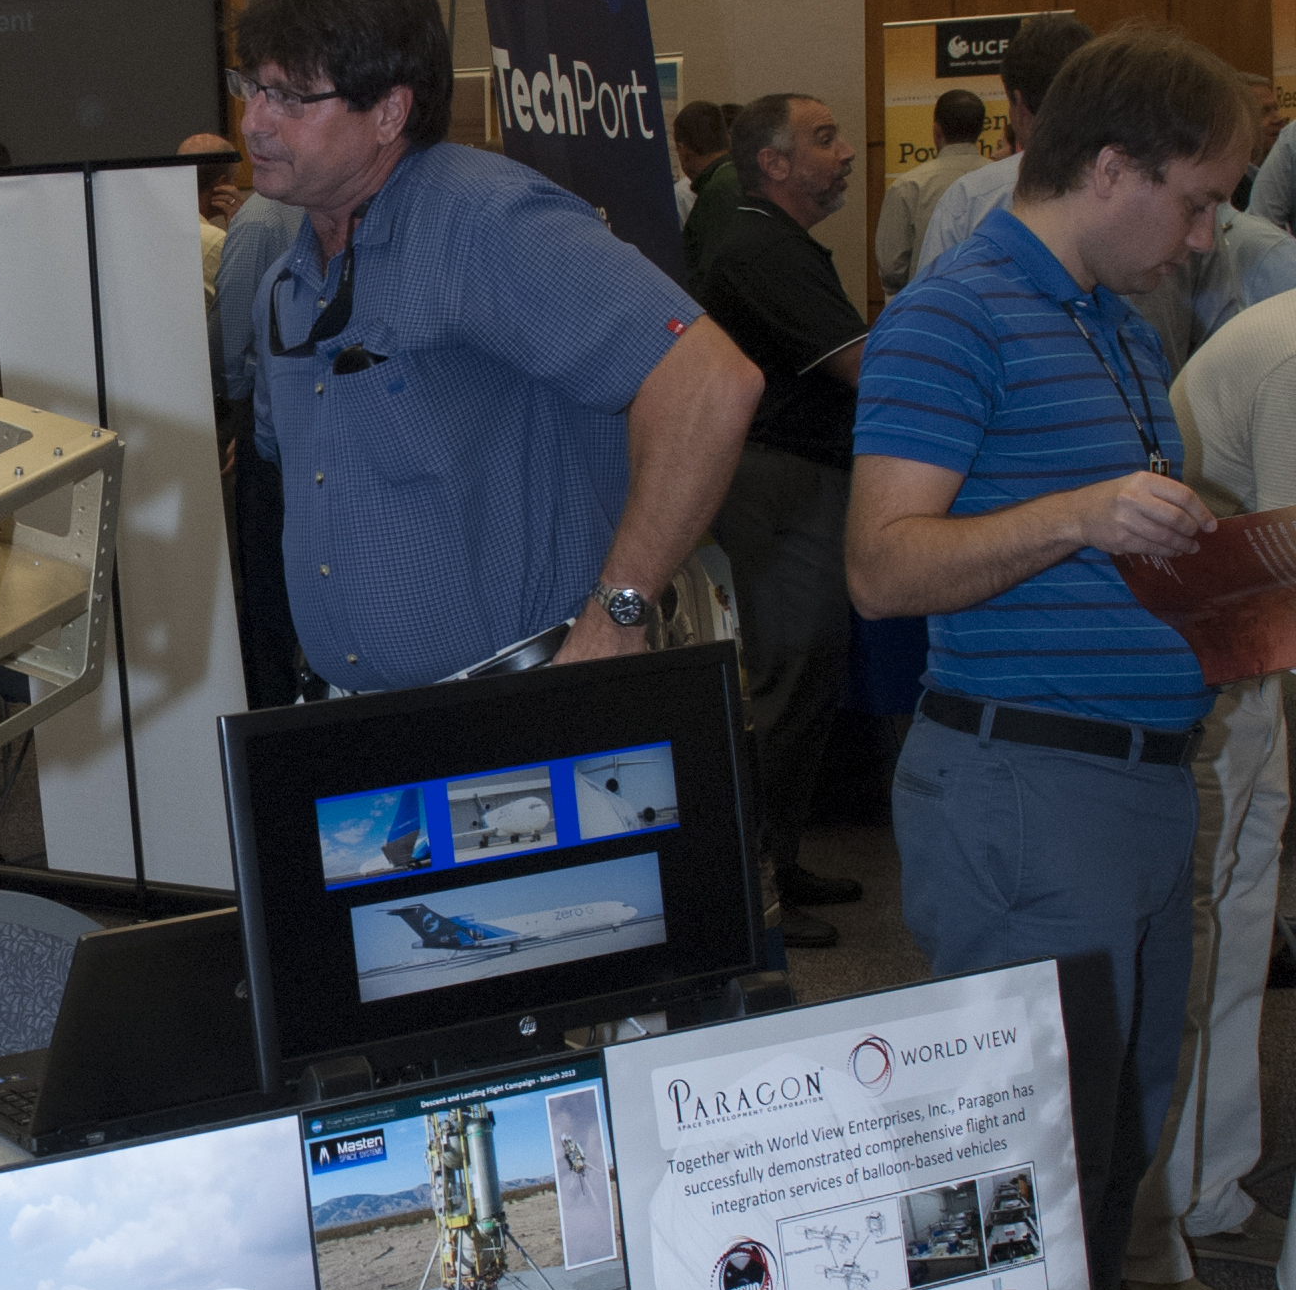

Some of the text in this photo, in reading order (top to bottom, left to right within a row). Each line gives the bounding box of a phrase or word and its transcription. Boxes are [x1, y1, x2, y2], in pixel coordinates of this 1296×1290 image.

[971, 39, 1010, 56] UCF
[491, 45, 654, 139] TechPort
[900, 1027, 1016, 1065] WORLD VIEW
[420, 1069, 575, 1108] Descent and Landing Flight Campaign March 2013
[668, 1069, 822, 1124] PARAGON
[666, 1084, 1034, 1174] Together with World View Enterprises, Inc., Paragon has
[677, 1096, 823, 1131] SPACE DEVELOPMENT CORPORATION
[336, 1135, 383, 1154] Masten
[684, 1107, 1025, 1196] successfully demonstrated comprehensive flight and
[711, 1138, 1007, 1215] integration services of balloon-based vehicles
